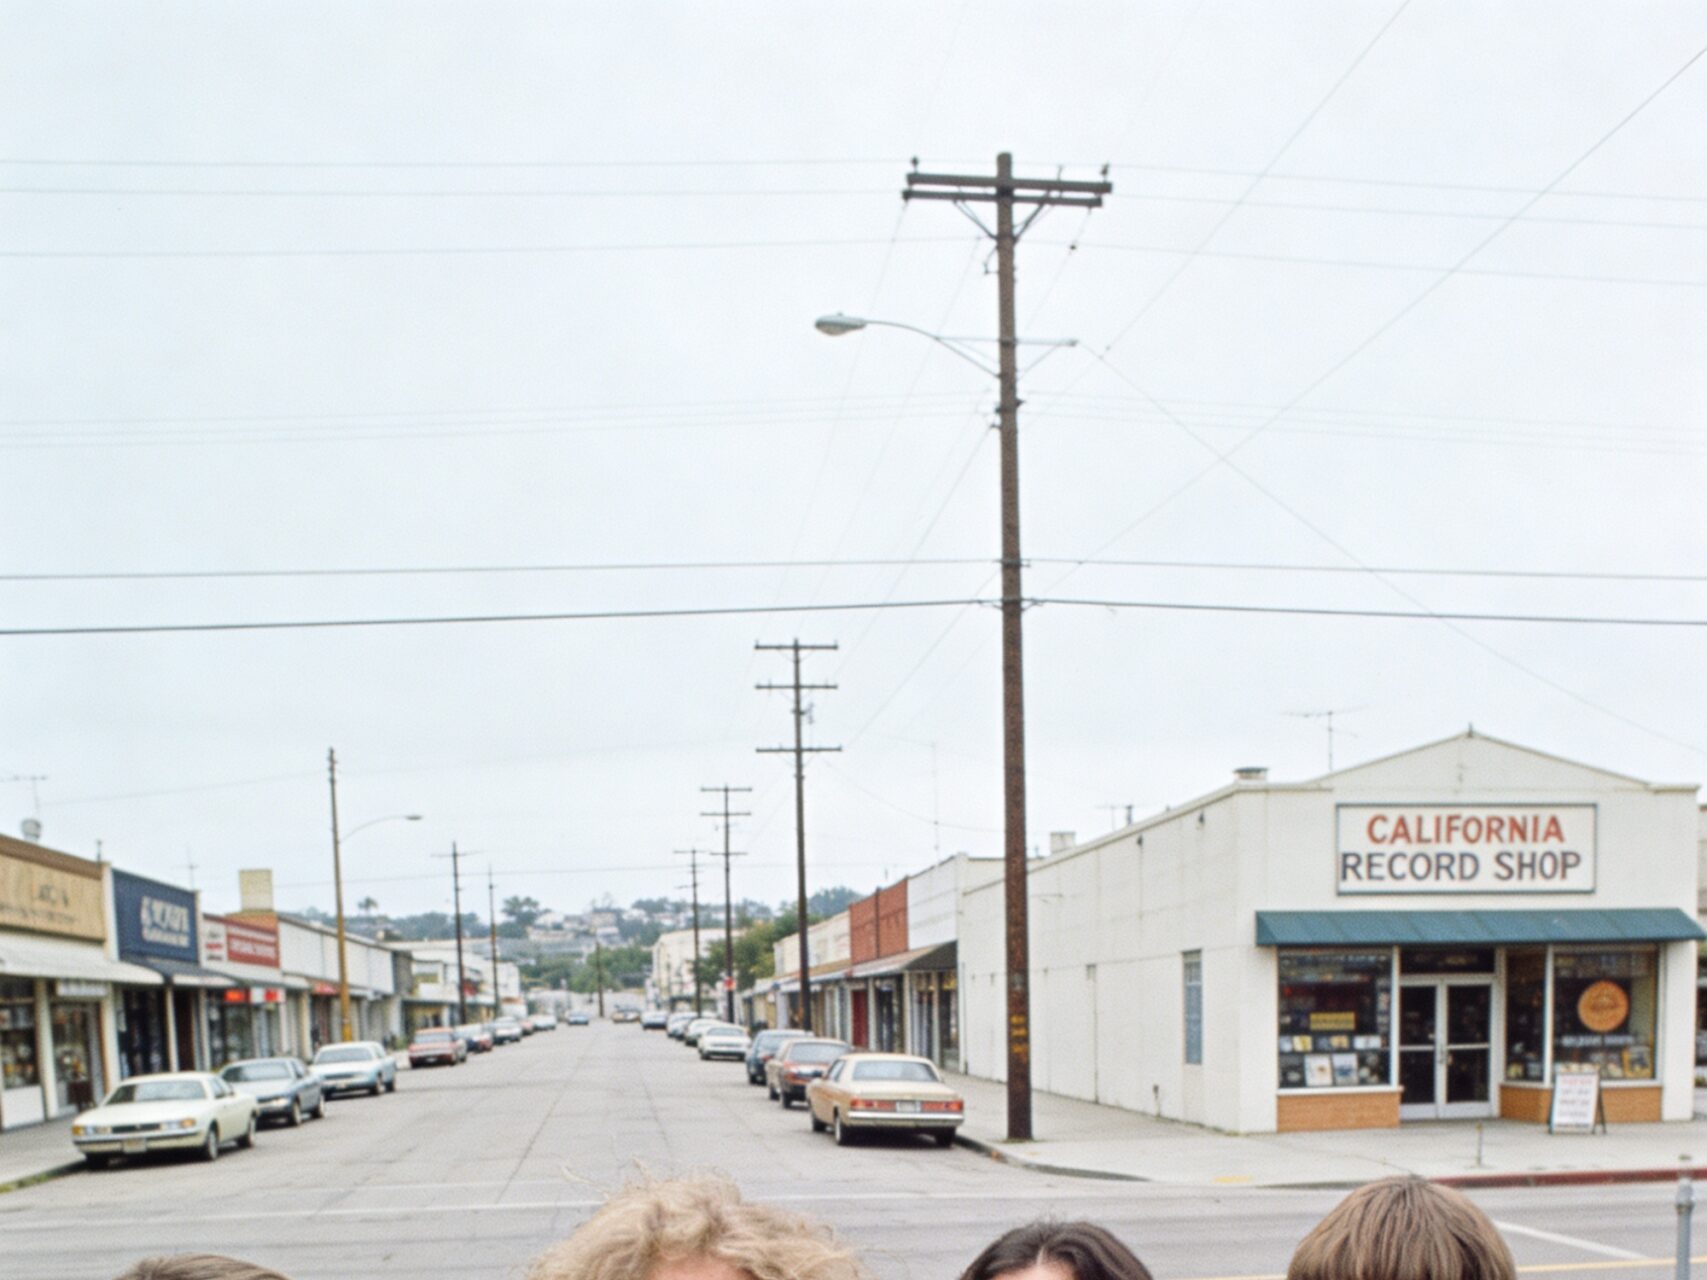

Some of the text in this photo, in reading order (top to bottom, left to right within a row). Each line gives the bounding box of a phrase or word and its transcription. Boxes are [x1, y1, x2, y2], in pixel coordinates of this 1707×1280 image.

[1367, 814, 1566, 845] CALIFORNIA
[1340, 850, 1581, 882] RECORD SHOP
